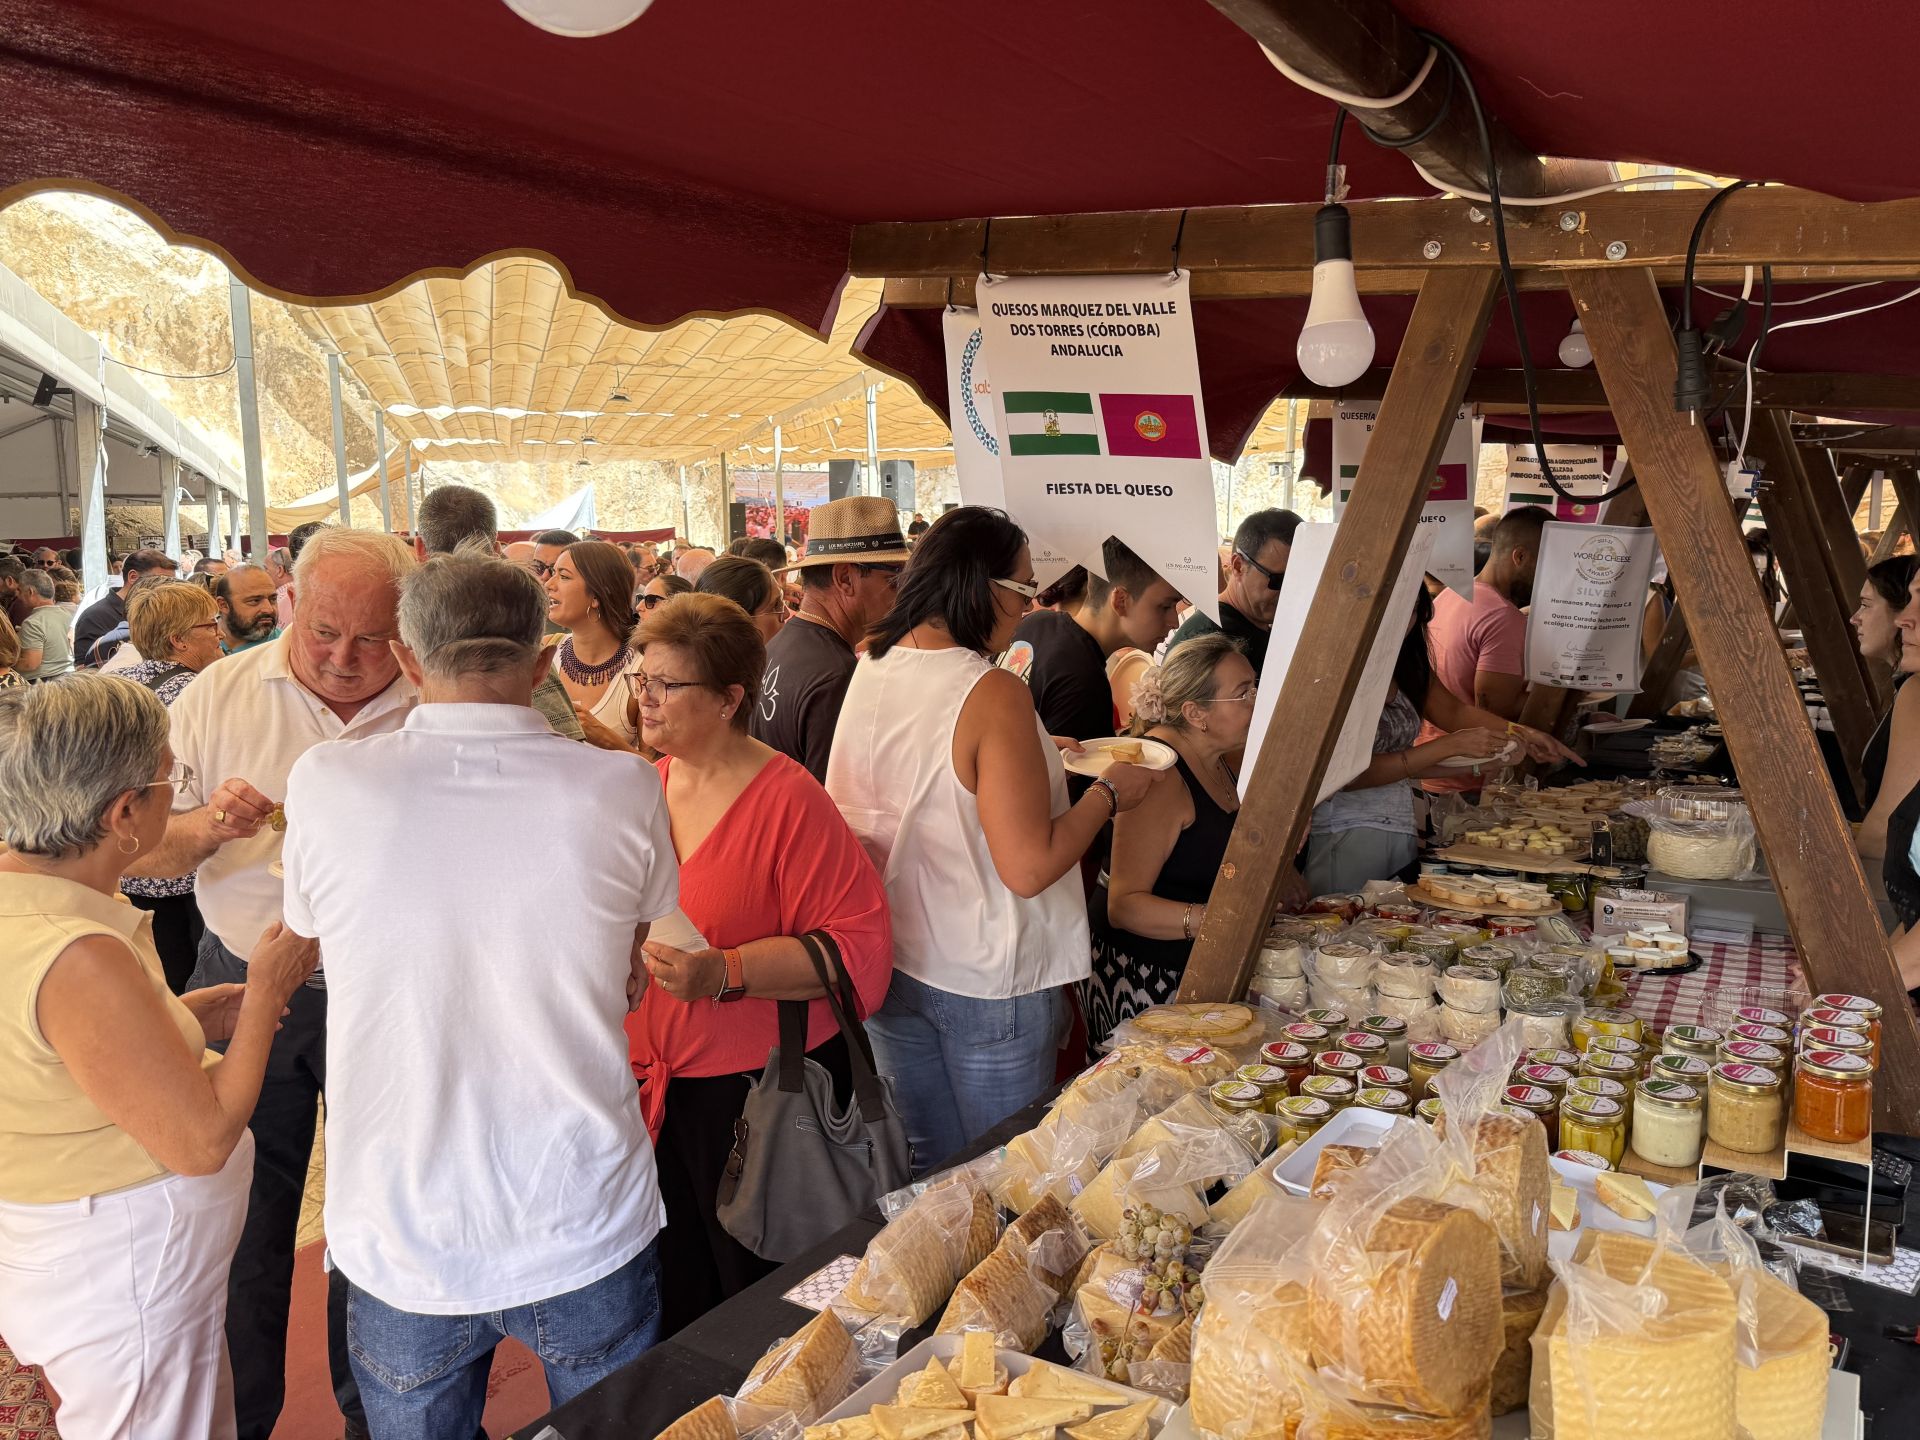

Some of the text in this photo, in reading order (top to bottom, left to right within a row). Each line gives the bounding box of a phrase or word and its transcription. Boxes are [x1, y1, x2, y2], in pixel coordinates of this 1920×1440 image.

[992, 301, 1177, 318] QUESOS MARQUEZ DEL VALLE
[1010, 322, 1160, 338] DOS TORRES (CÓRDOBA)
[1051, 344, 1123, 357] ANDALUCIA
[1046, 483, 1173, 496] FIESTA DEL QUESO
[1418, 515, 1446, 523] UESO
[1573, 552, 1603, 560] WORLD
[1587, 568, 1614, 577] AWARDS
[1576, 587, 1617, 598] SILVER
[1551, 598, 1583, 606] Hermanos
